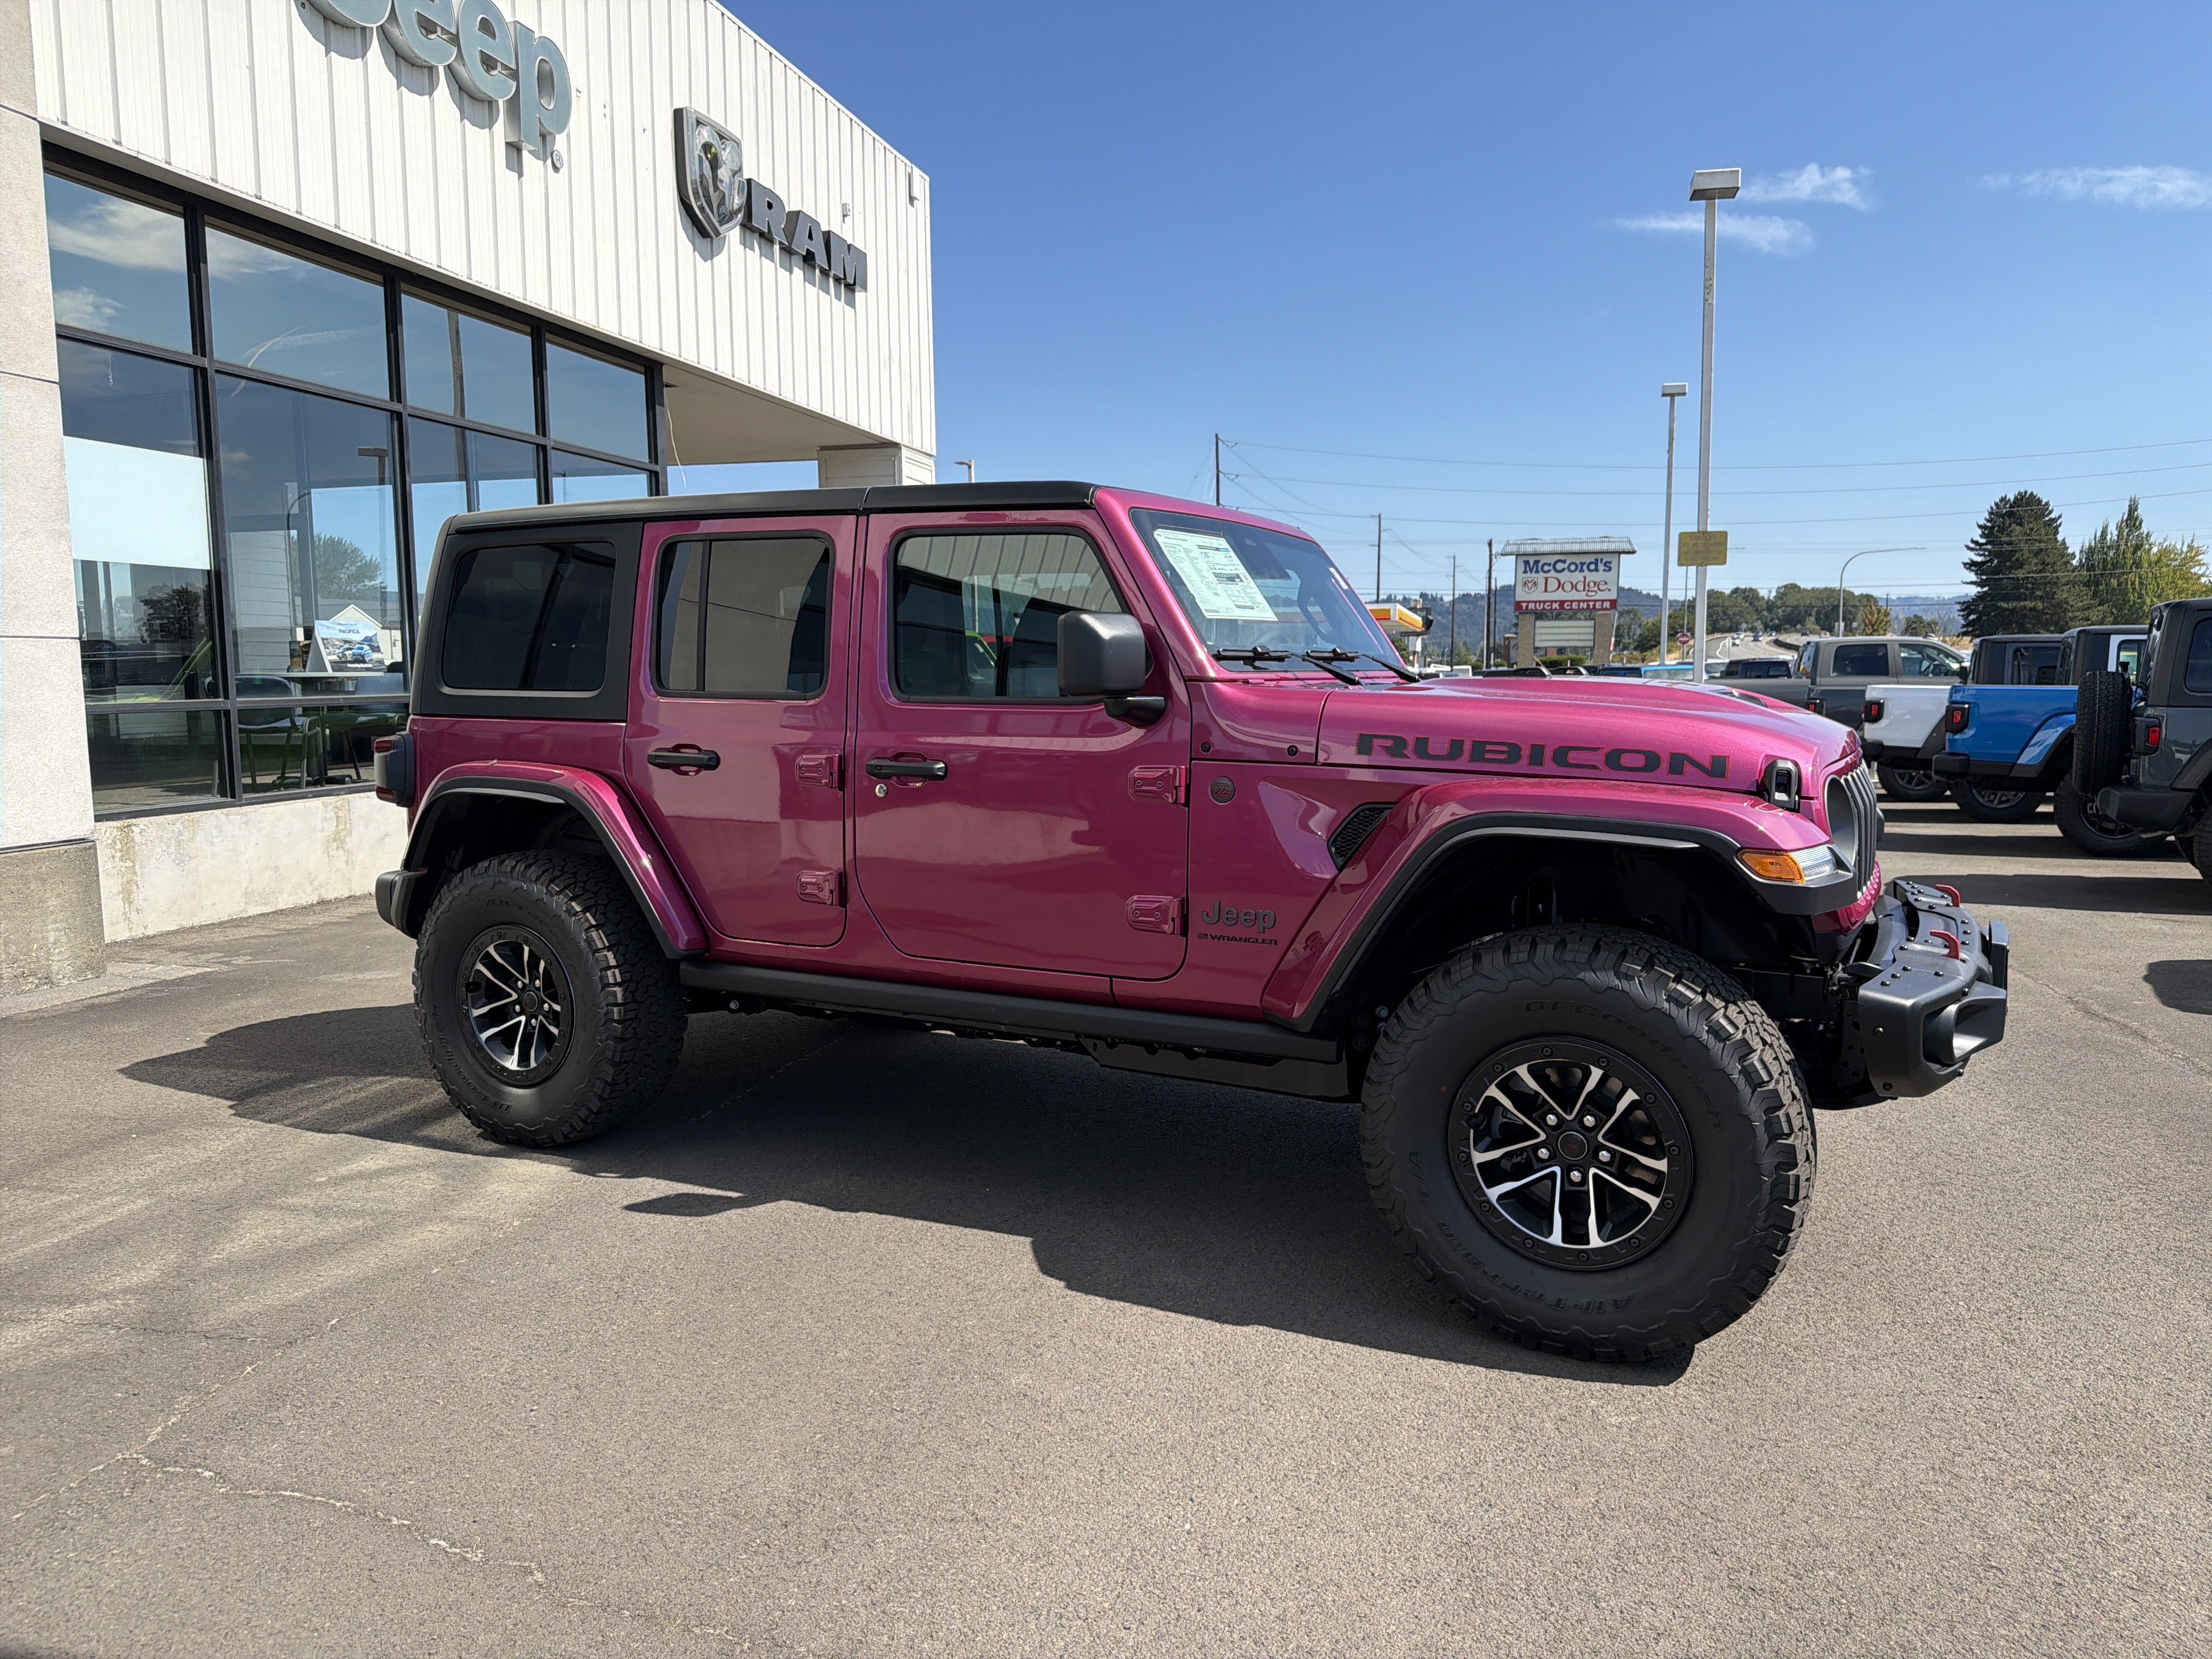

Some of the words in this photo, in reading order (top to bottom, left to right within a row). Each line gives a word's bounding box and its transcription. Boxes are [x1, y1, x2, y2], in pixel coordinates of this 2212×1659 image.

[295, 0, 572, 150] eep
[747, 178, 867, 293] RAM
[1522, 558, 1612, 574] McCord's
[1564, 601, 1611, 610] CENTER
[1357, 733, 1729, 779] RUBICON
[1201, 900, 1277, 934] Jeep
[1209, 934, 1278, 945] WRANGLER
